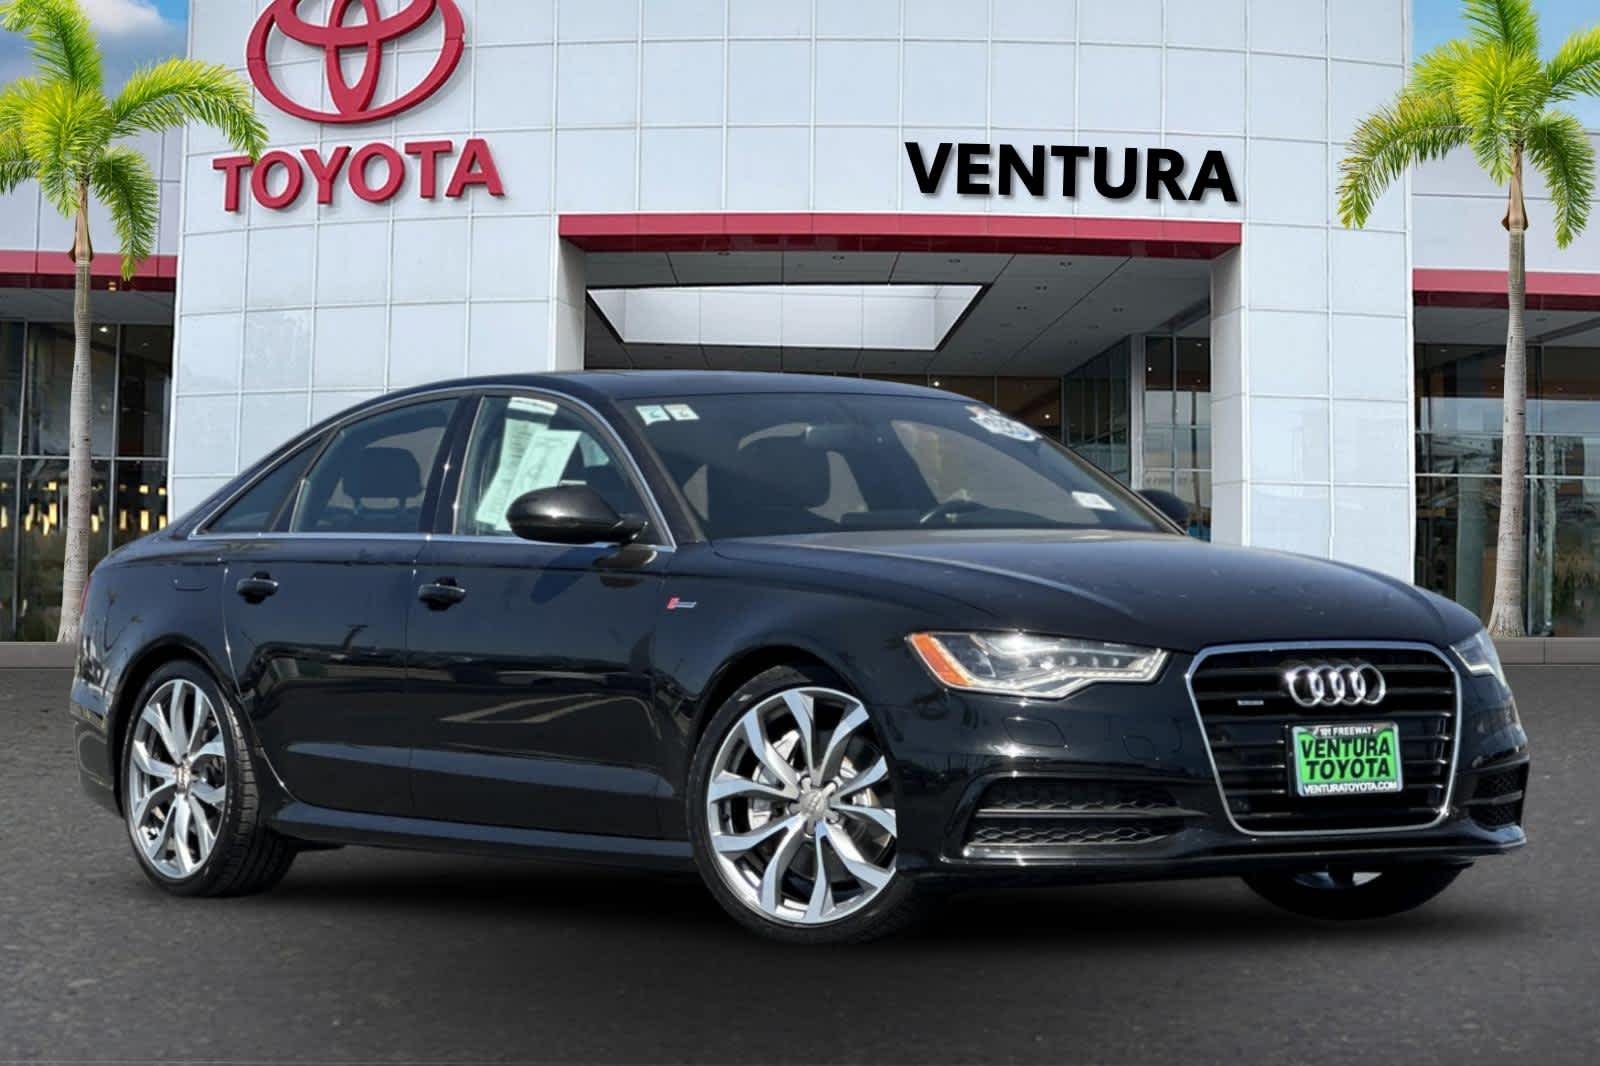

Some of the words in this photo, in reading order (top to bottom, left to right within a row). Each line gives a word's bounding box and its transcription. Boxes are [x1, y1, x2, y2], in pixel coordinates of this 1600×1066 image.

[212, 138, 505, 212] TOYOTA
[904, 141, 1240, 203] VENTURA
[1301, 737, 1391, 759] VENTURA
[1306, 758, 1391, 780] TOYOTA
[1304, 781, 1398, 794] VENTURATOYOTA.COM
